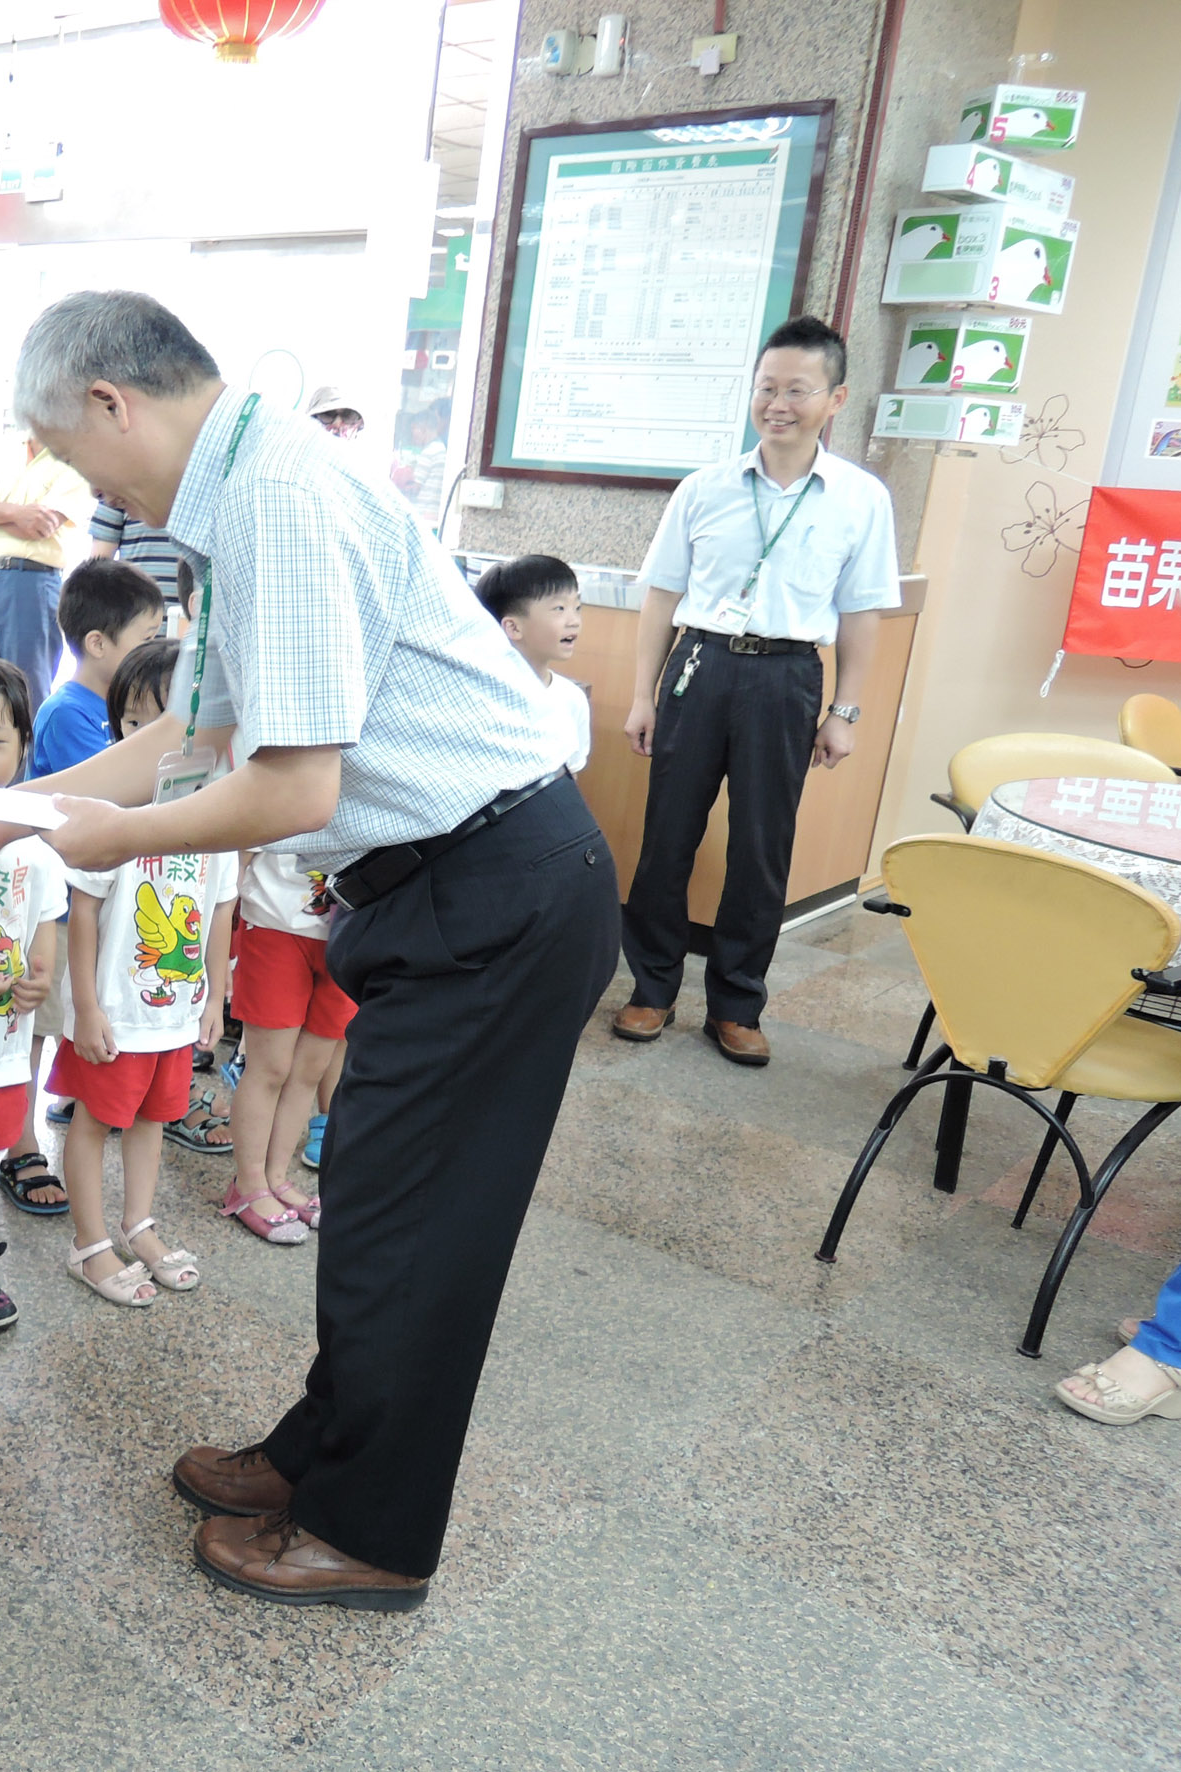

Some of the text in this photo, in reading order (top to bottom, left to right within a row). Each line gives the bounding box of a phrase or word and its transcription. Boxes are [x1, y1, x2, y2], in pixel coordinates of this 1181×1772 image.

[990, 116, 1008, 143] 5
[988, 276, 999, 300] 3
[950, 365, 965, 389] 2
[958, 417, 966, 440] 1
